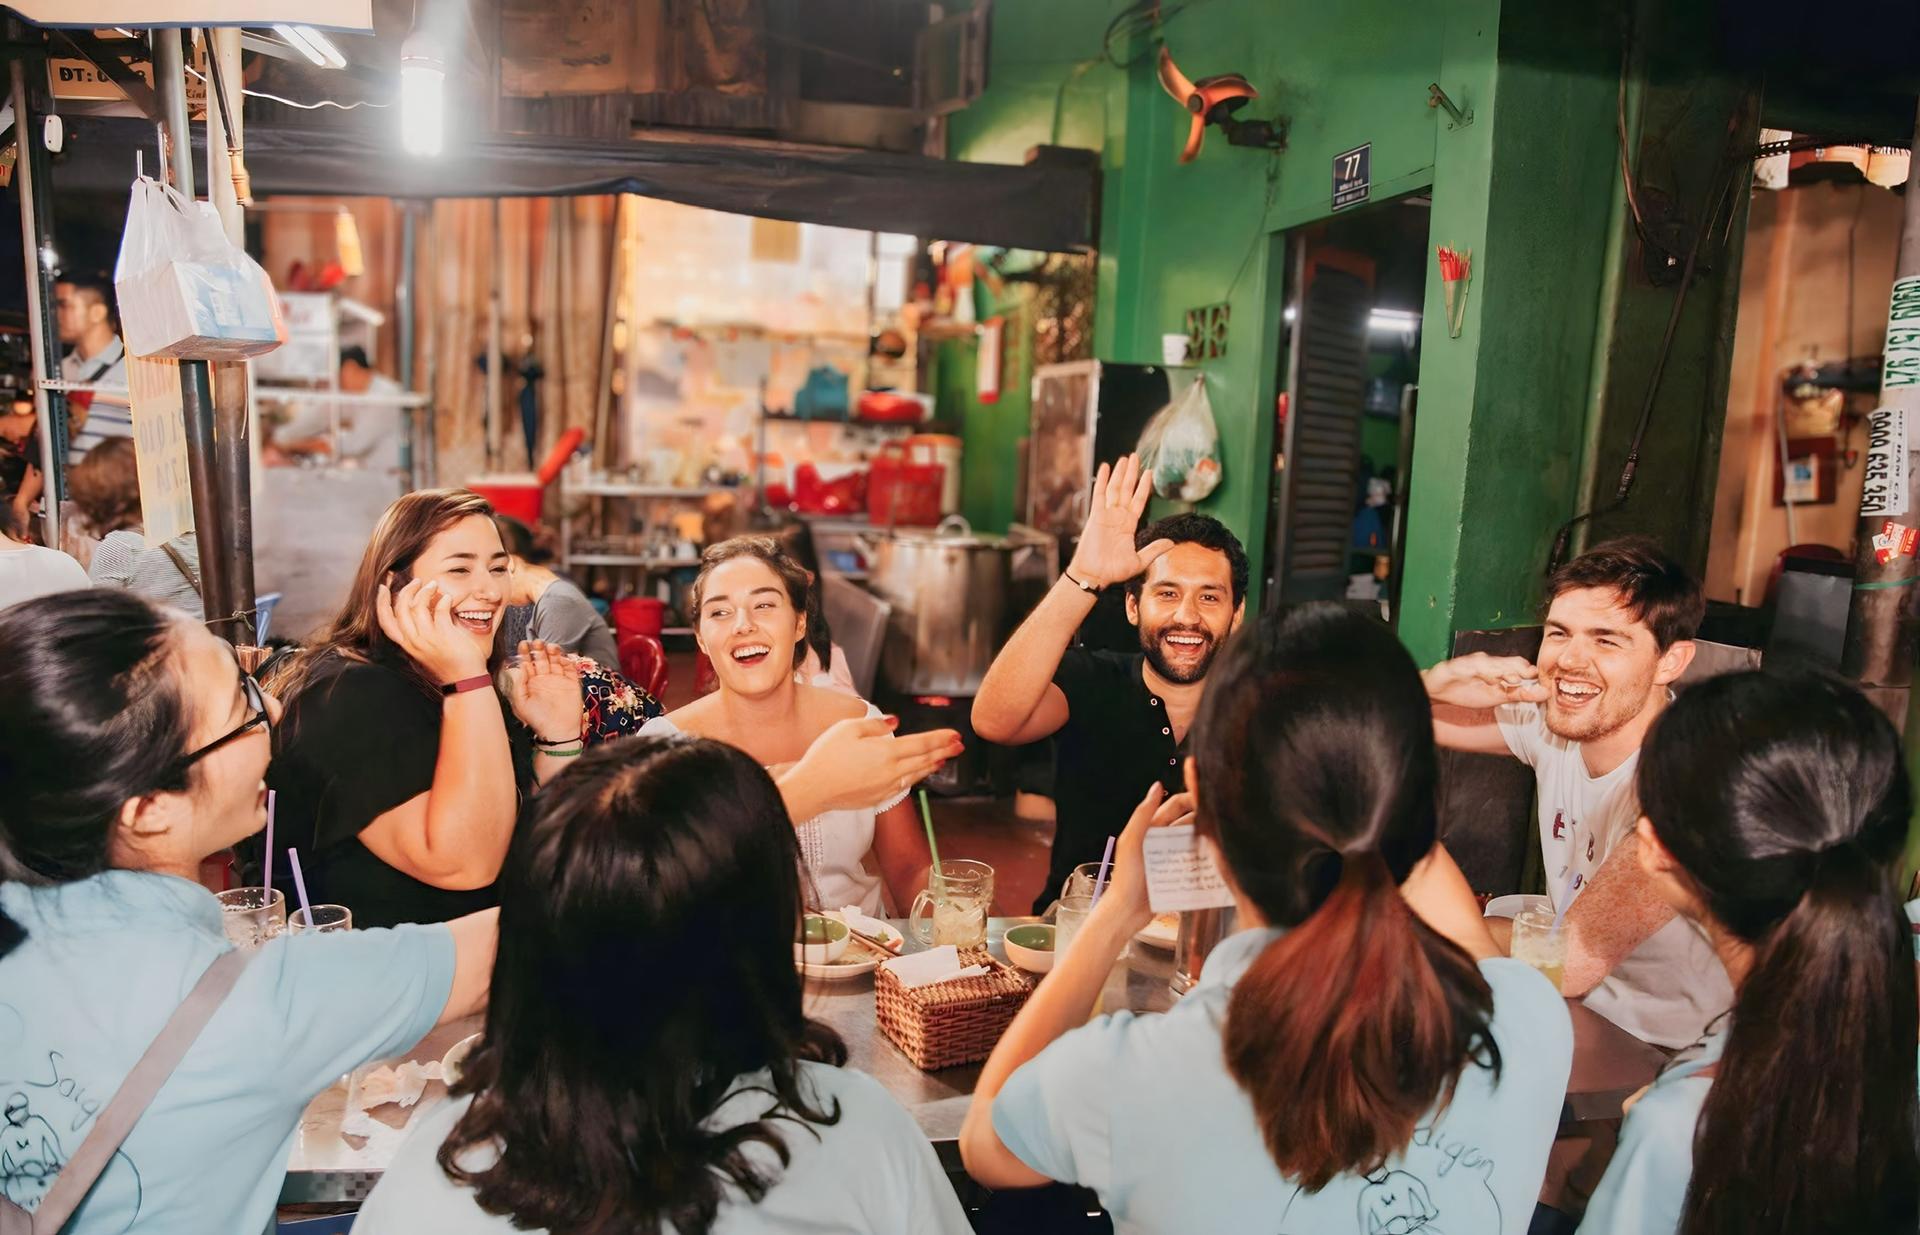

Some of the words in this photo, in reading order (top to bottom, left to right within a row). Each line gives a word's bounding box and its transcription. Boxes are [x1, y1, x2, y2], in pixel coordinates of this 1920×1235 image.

[1344, 153, 1361, 181] 77
[1871, 411, 1892, 449] 0909
[1864, 453, 1889, 481] 635
[1860, 484, 1887, 512] 350
